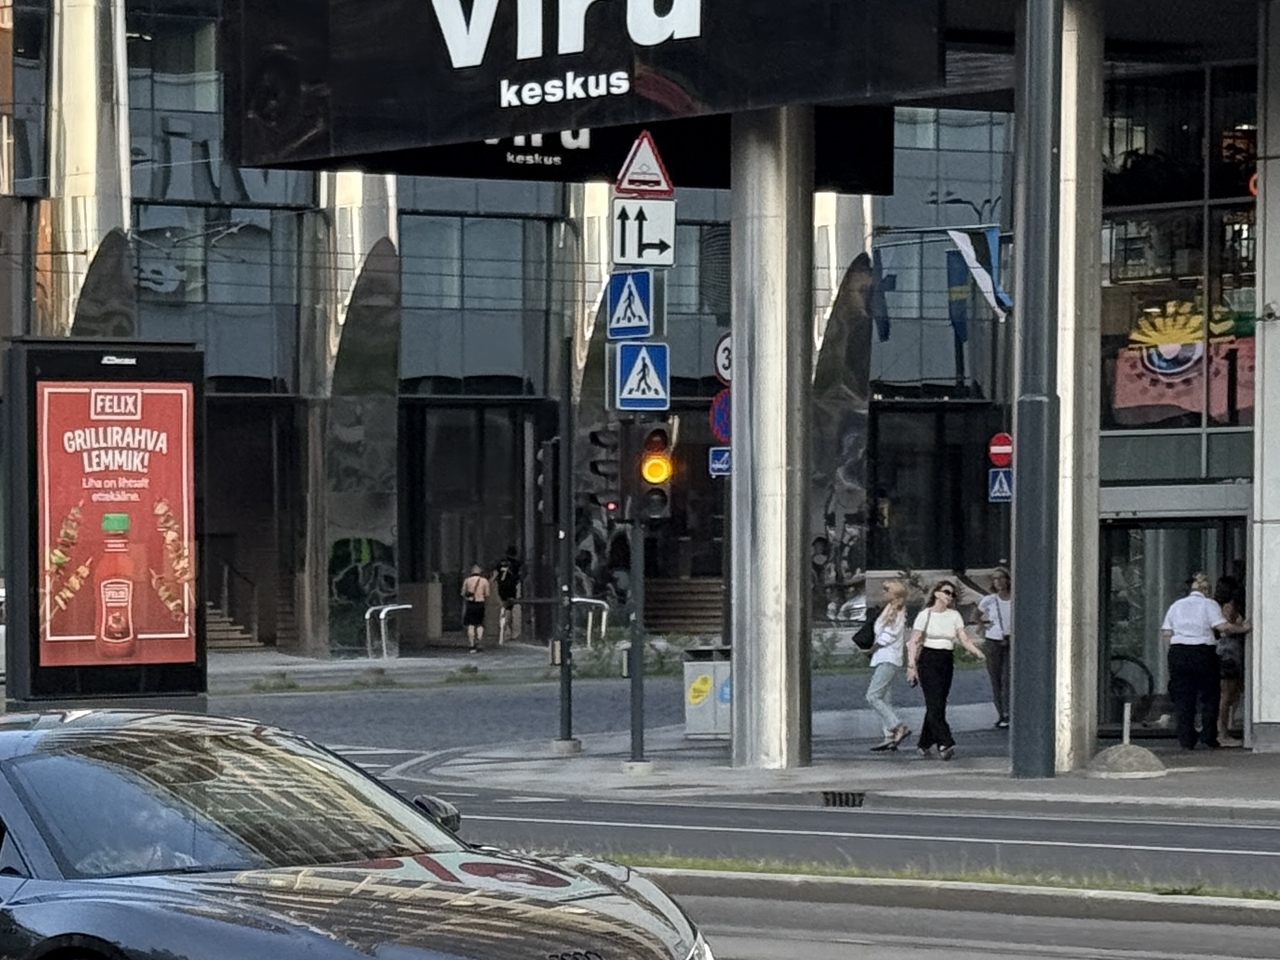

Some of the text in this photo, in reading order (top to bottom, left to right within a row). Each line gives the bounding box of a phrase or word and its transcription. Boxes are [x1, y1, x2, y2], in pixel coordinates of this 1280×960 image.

[499, 71, 630, 108] keskus
[506, 151, 562, 166] keskus
[96, 395, 136, 413] FELIX
[63, 427, 168, 454] GRILLIRAHVA
[83, 450, 150, 473] LEMMIK!
[103, 479, 117, 489] on
